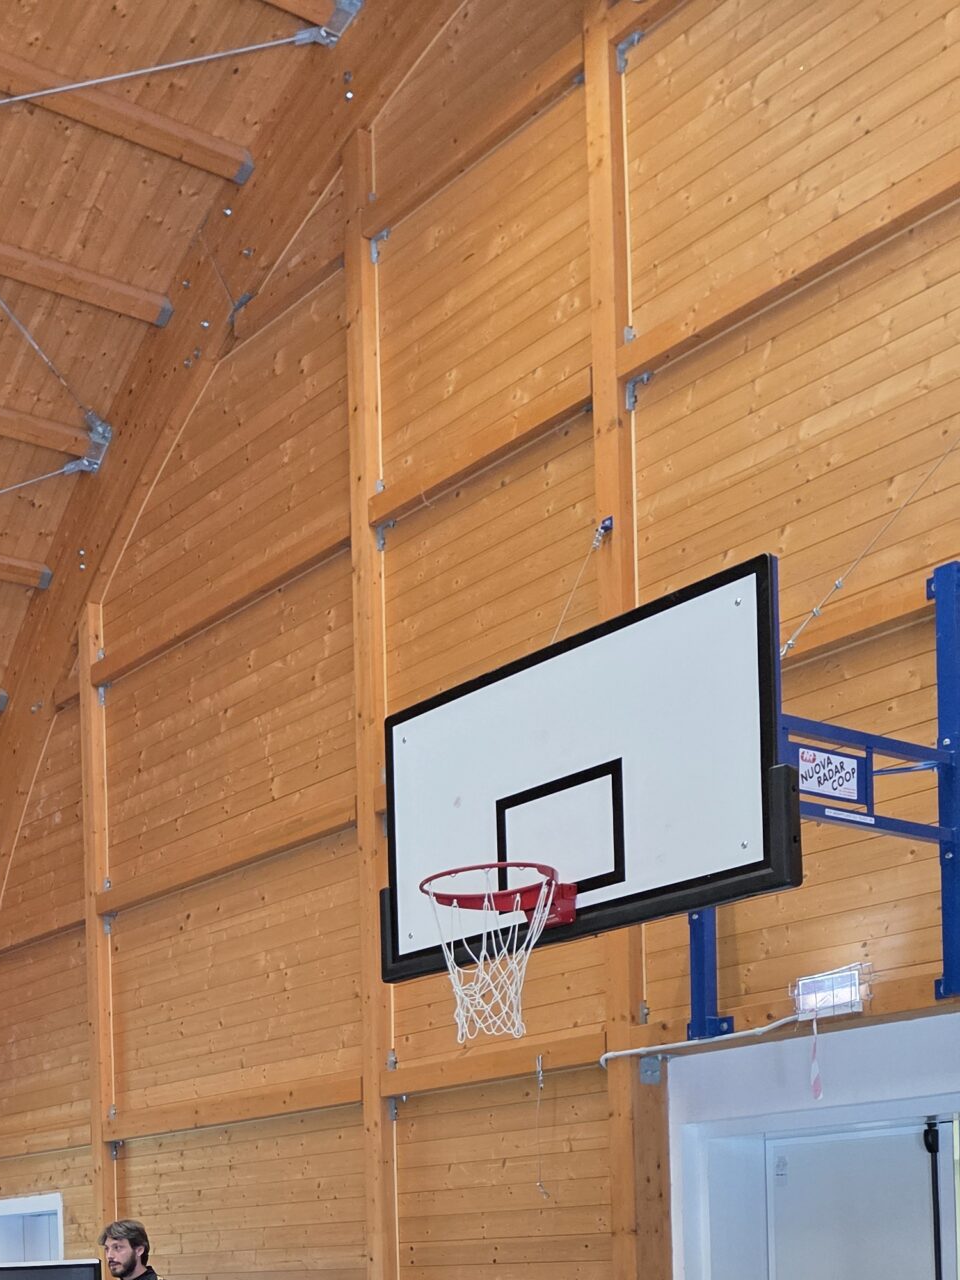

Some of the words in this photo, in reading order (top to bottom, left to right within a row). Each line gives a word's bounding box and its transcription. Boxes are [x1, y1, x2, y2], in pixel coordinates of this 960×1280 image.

[800, 755, 833, 785] NUOVA
[816, 760, 846, 787] RADAR
[831, 767, 856, 791] COOP
